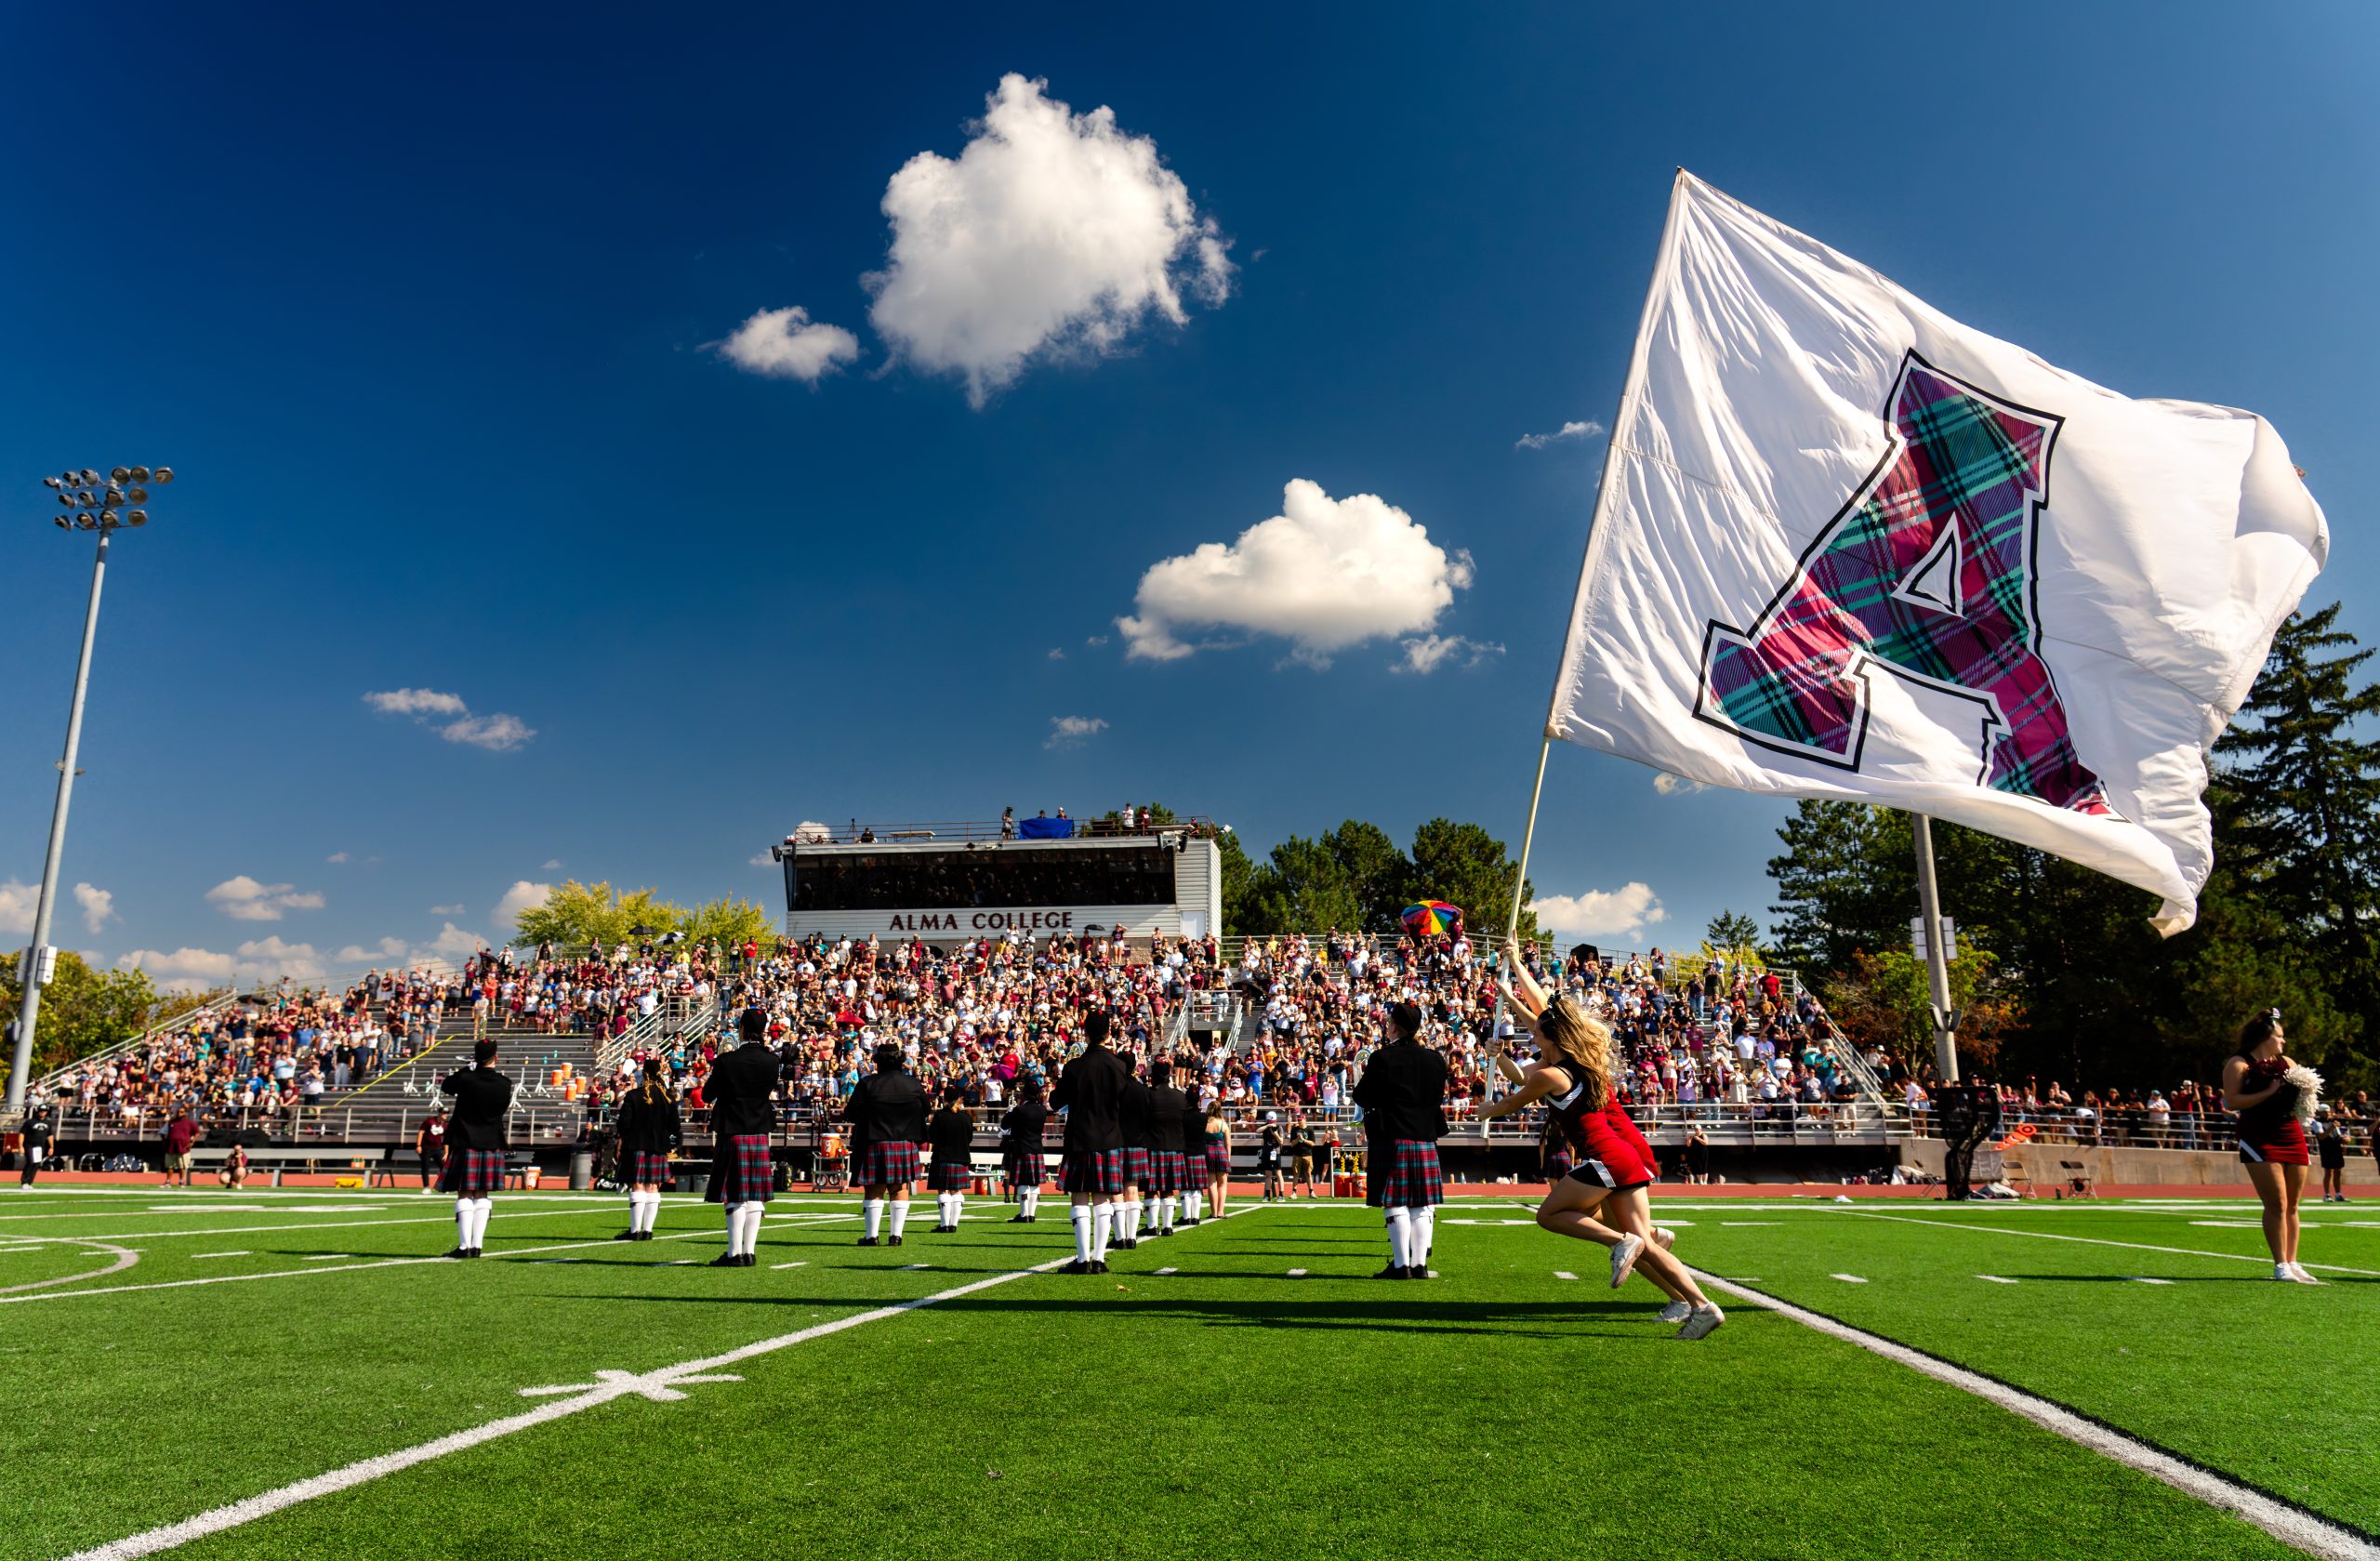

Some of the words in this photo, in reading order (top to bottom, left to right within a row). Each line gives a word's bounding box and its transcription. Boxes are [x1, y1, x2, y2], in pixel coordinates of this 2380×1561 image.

[1692, 347, 2131, 823] A
[890, 913, 958, 930] ALMA
[972, 911, 1073, 930] COLLEGE
